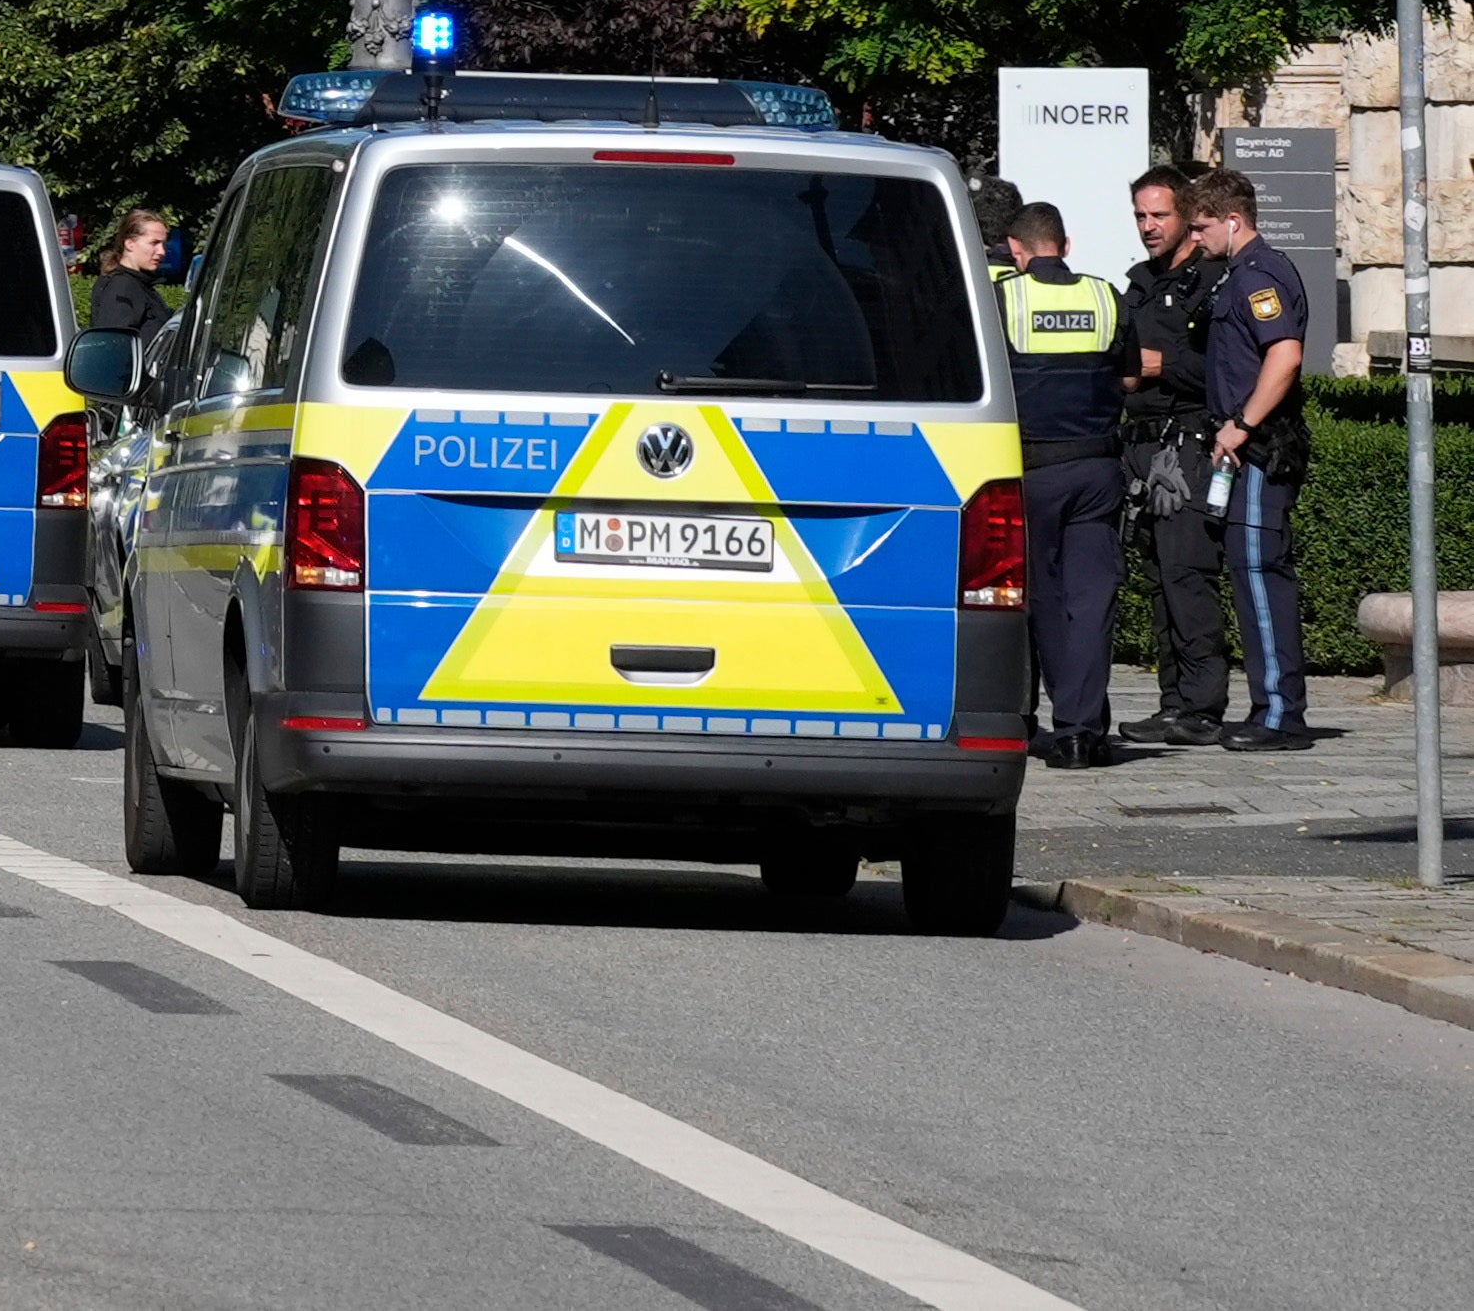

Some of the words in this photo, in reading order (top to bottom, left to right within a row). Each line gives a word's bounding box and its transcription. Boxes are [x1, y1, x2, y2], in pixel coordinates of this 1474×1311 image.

[1042, 104, 1129, 125] NOERR
[1236, 137, 1292, 148] Bayerische
[1268, 148, 1285, 158] AG
[1033, 314, 1094, 330] POLIZEI
[414, 434, 558, 470] POLIZEI
[579, 518, 601, 550] M
[627, 520, 671, 553] PM
[680, 523, 766, 557] 9166
